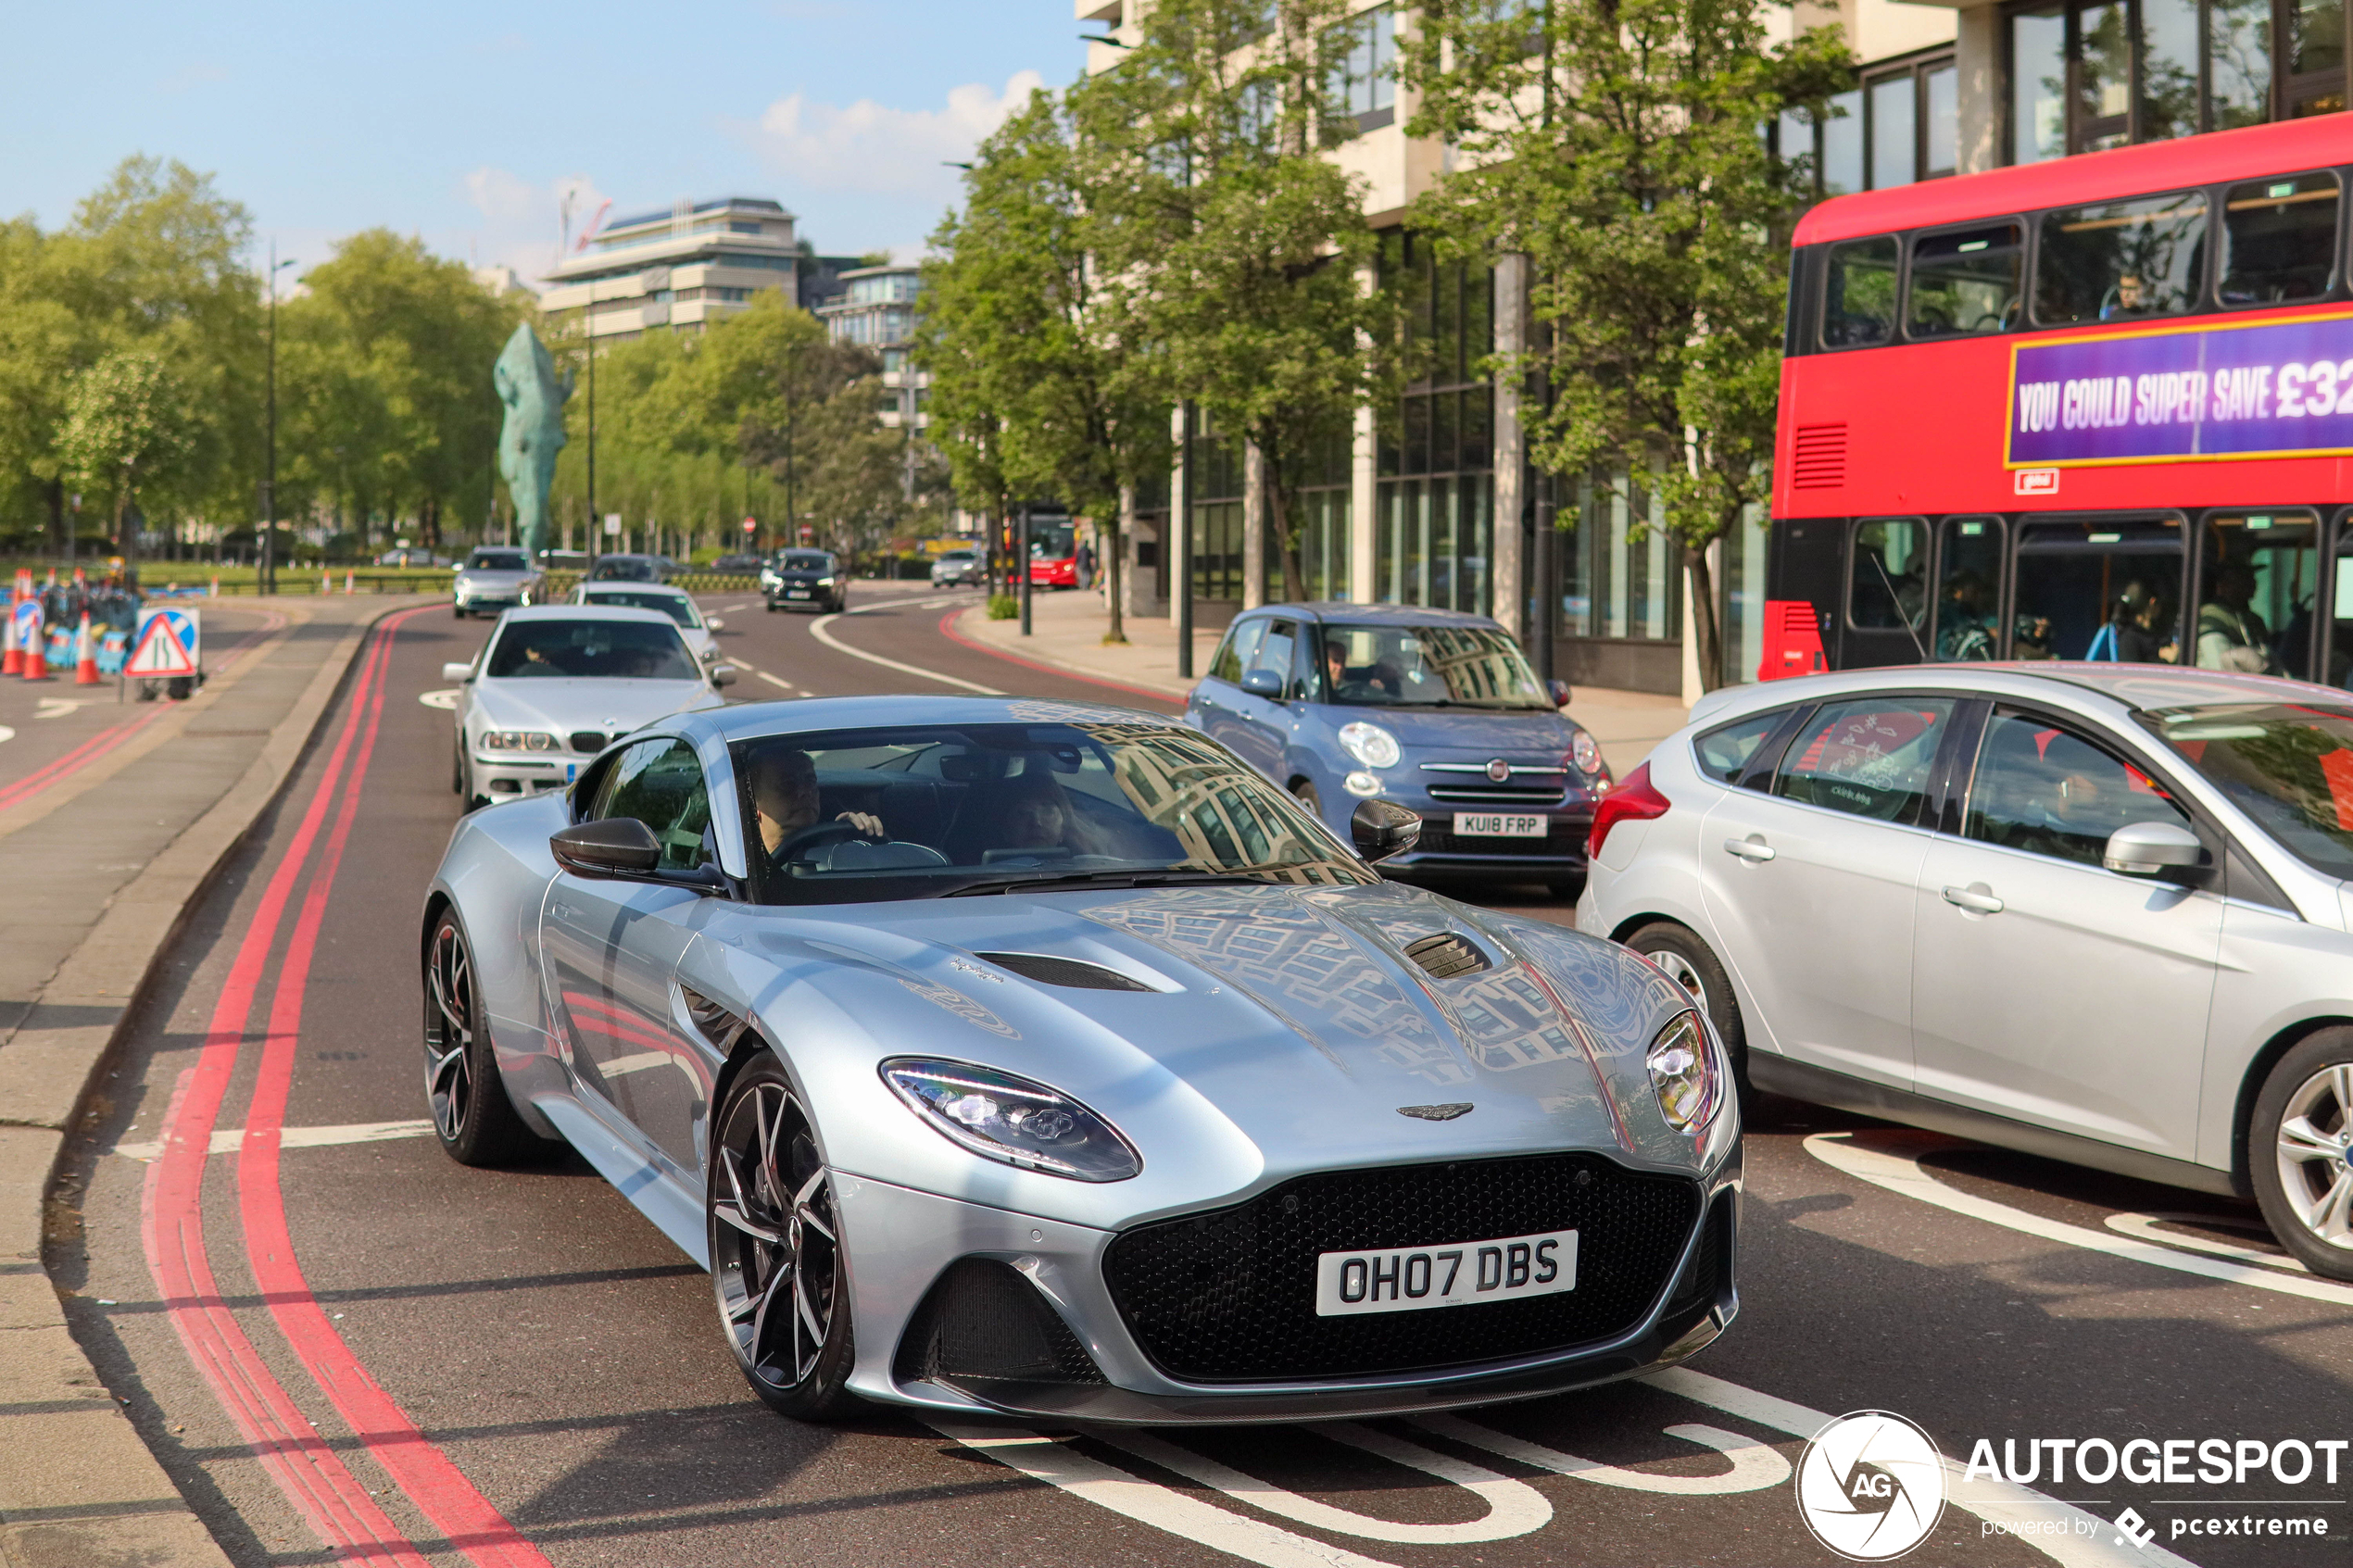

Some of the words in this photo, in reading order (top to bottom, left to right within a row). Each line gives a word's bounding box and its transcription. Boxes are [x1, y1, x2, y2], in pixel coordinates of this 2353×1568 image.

[2019, 382, 2060, 433] YOU
[2062, 376, 2132, 431] COULD
[2134, 371, 2208, 425] SUPER
[2212, 366, 2271, 420] SAVE
[1465, 817, 1501, 833] KU18
[1506, 818, 1537, 833] FRP
[1340, 1250, 1463, 1303] OH07
[1476, 1239, 1559, 1292] DBS
